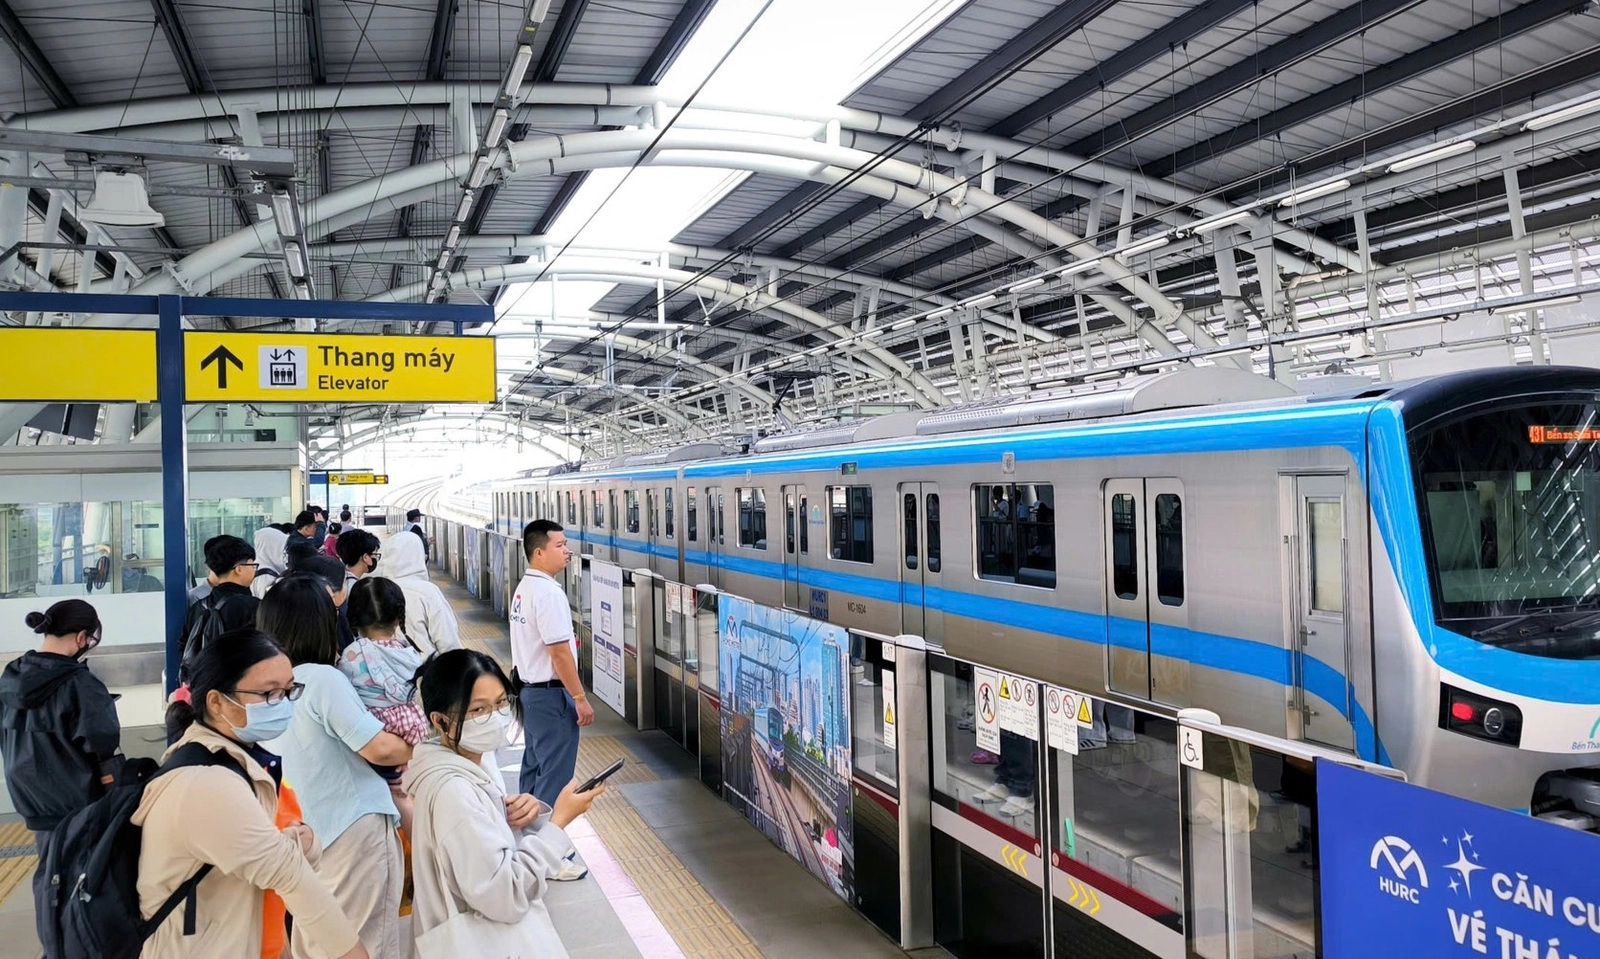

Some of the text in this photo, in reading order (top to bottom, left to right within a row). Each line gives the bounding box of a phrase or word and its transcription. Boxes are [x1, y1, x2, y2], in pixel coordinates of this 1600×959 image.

[318, 345, 455, 373] Thang máy
[318, 374, 389, 390] Elevator
[1379, 876, 1420, 904] HURC
[1491, 872, 1554, 917] CĂN
[1447, 907, 1487, 954] VÉ
